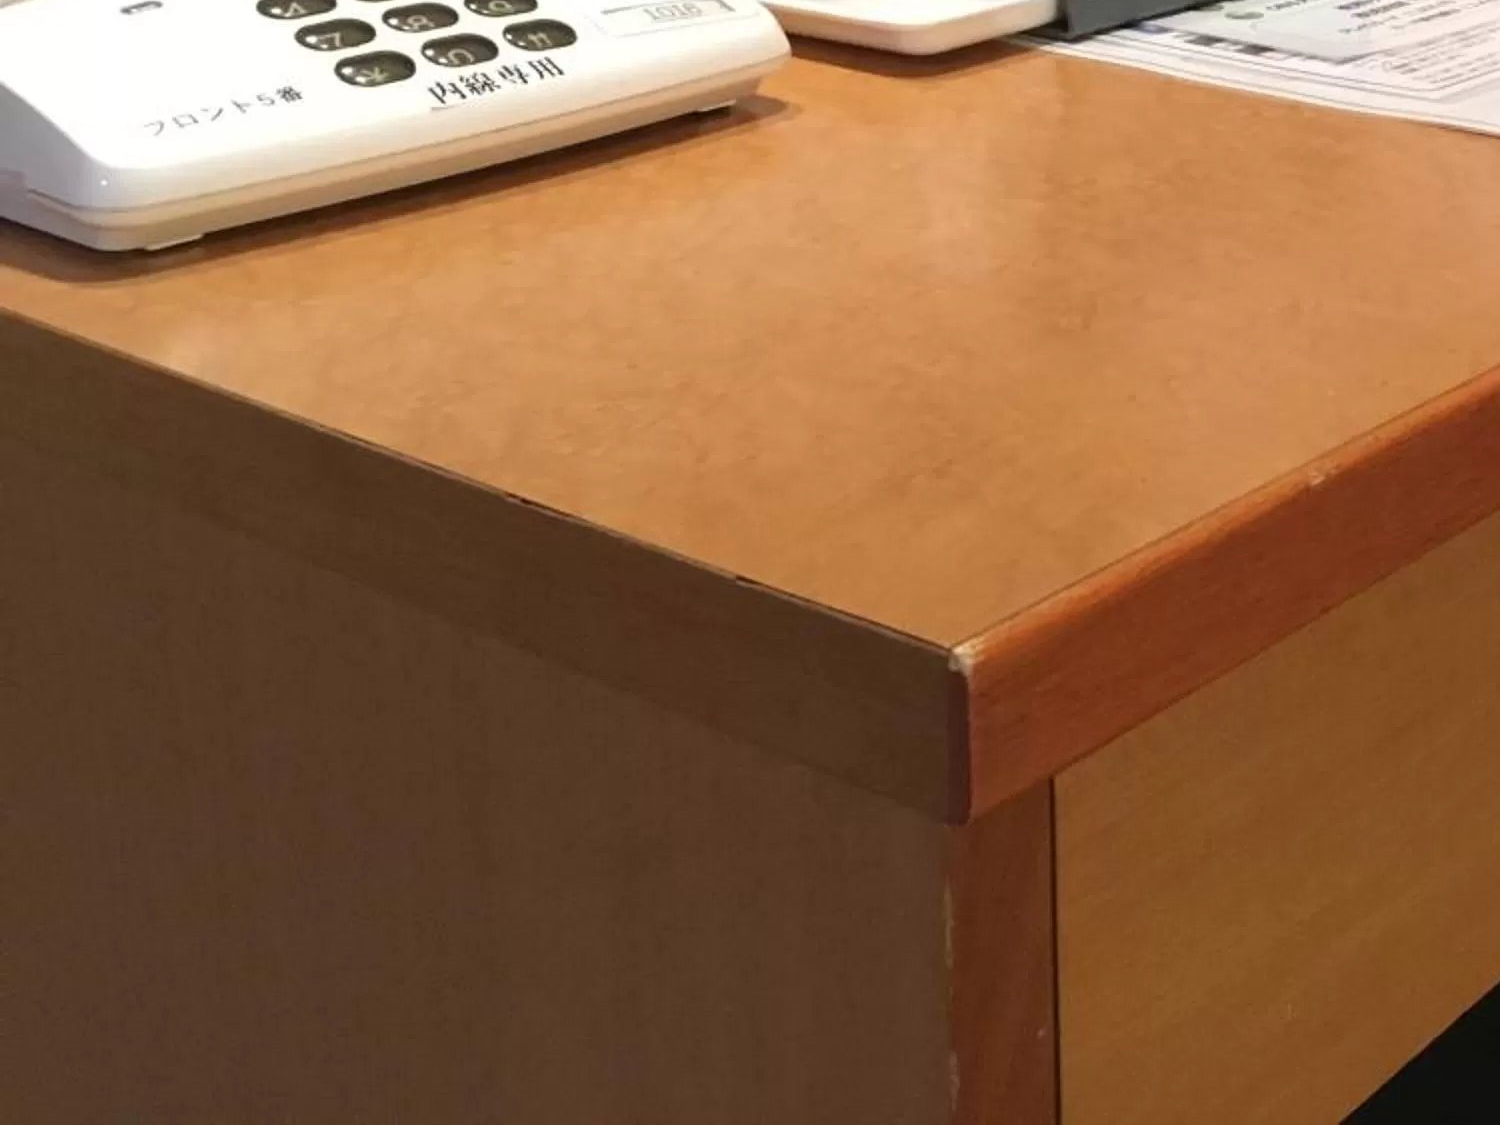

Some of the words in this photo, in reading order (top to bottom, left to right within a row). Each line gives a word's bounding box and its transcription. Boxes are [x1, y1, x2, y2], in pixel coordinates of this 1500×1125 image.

[427, 56, 566, 105] 内線専用
[143, 85, 303, 137] フロント5番
